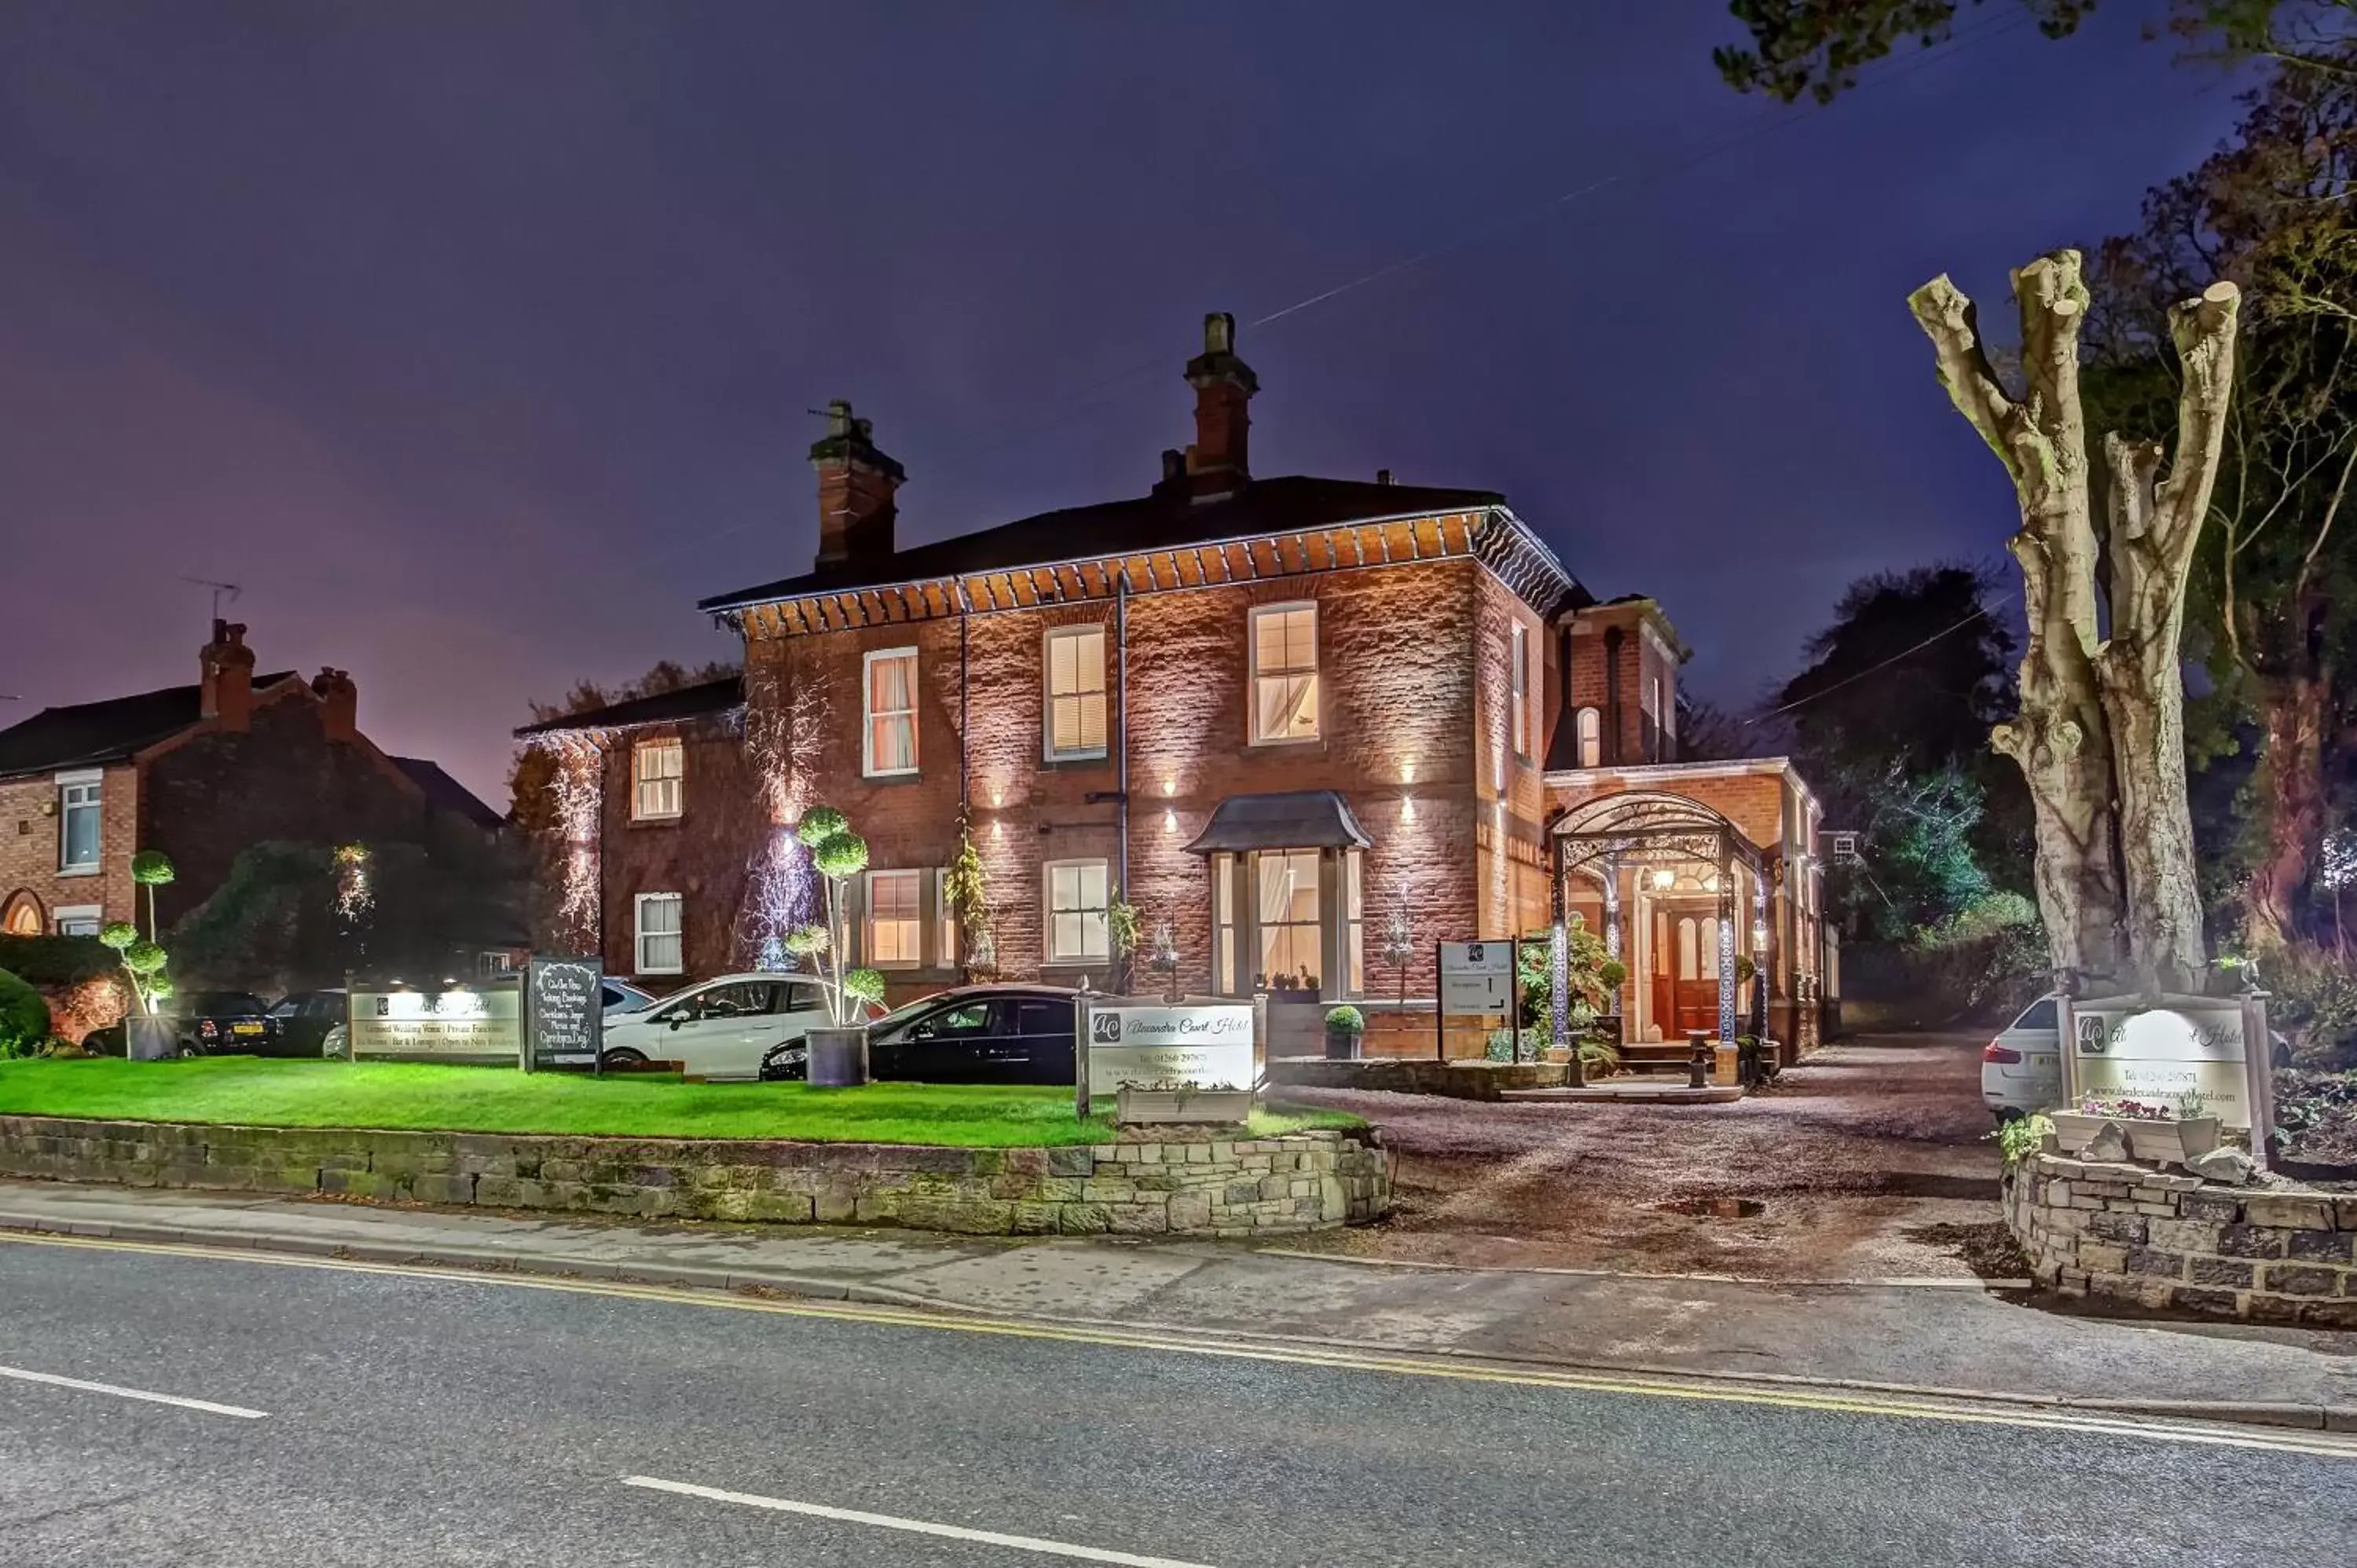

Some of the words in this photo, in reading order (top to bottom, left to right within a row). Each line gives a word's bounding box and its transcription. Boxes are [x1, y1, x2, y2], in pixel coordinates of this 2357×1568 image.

[393, 1024, 421, 1034] Wedding
[1126, 1019, 1176, 1034] Alexandra
[1179, 1017, 1209, 1034] Court
[1211, 1017, 1250, 1035] Hotel
[2200, 1022, 2243, 1046] Hotel
